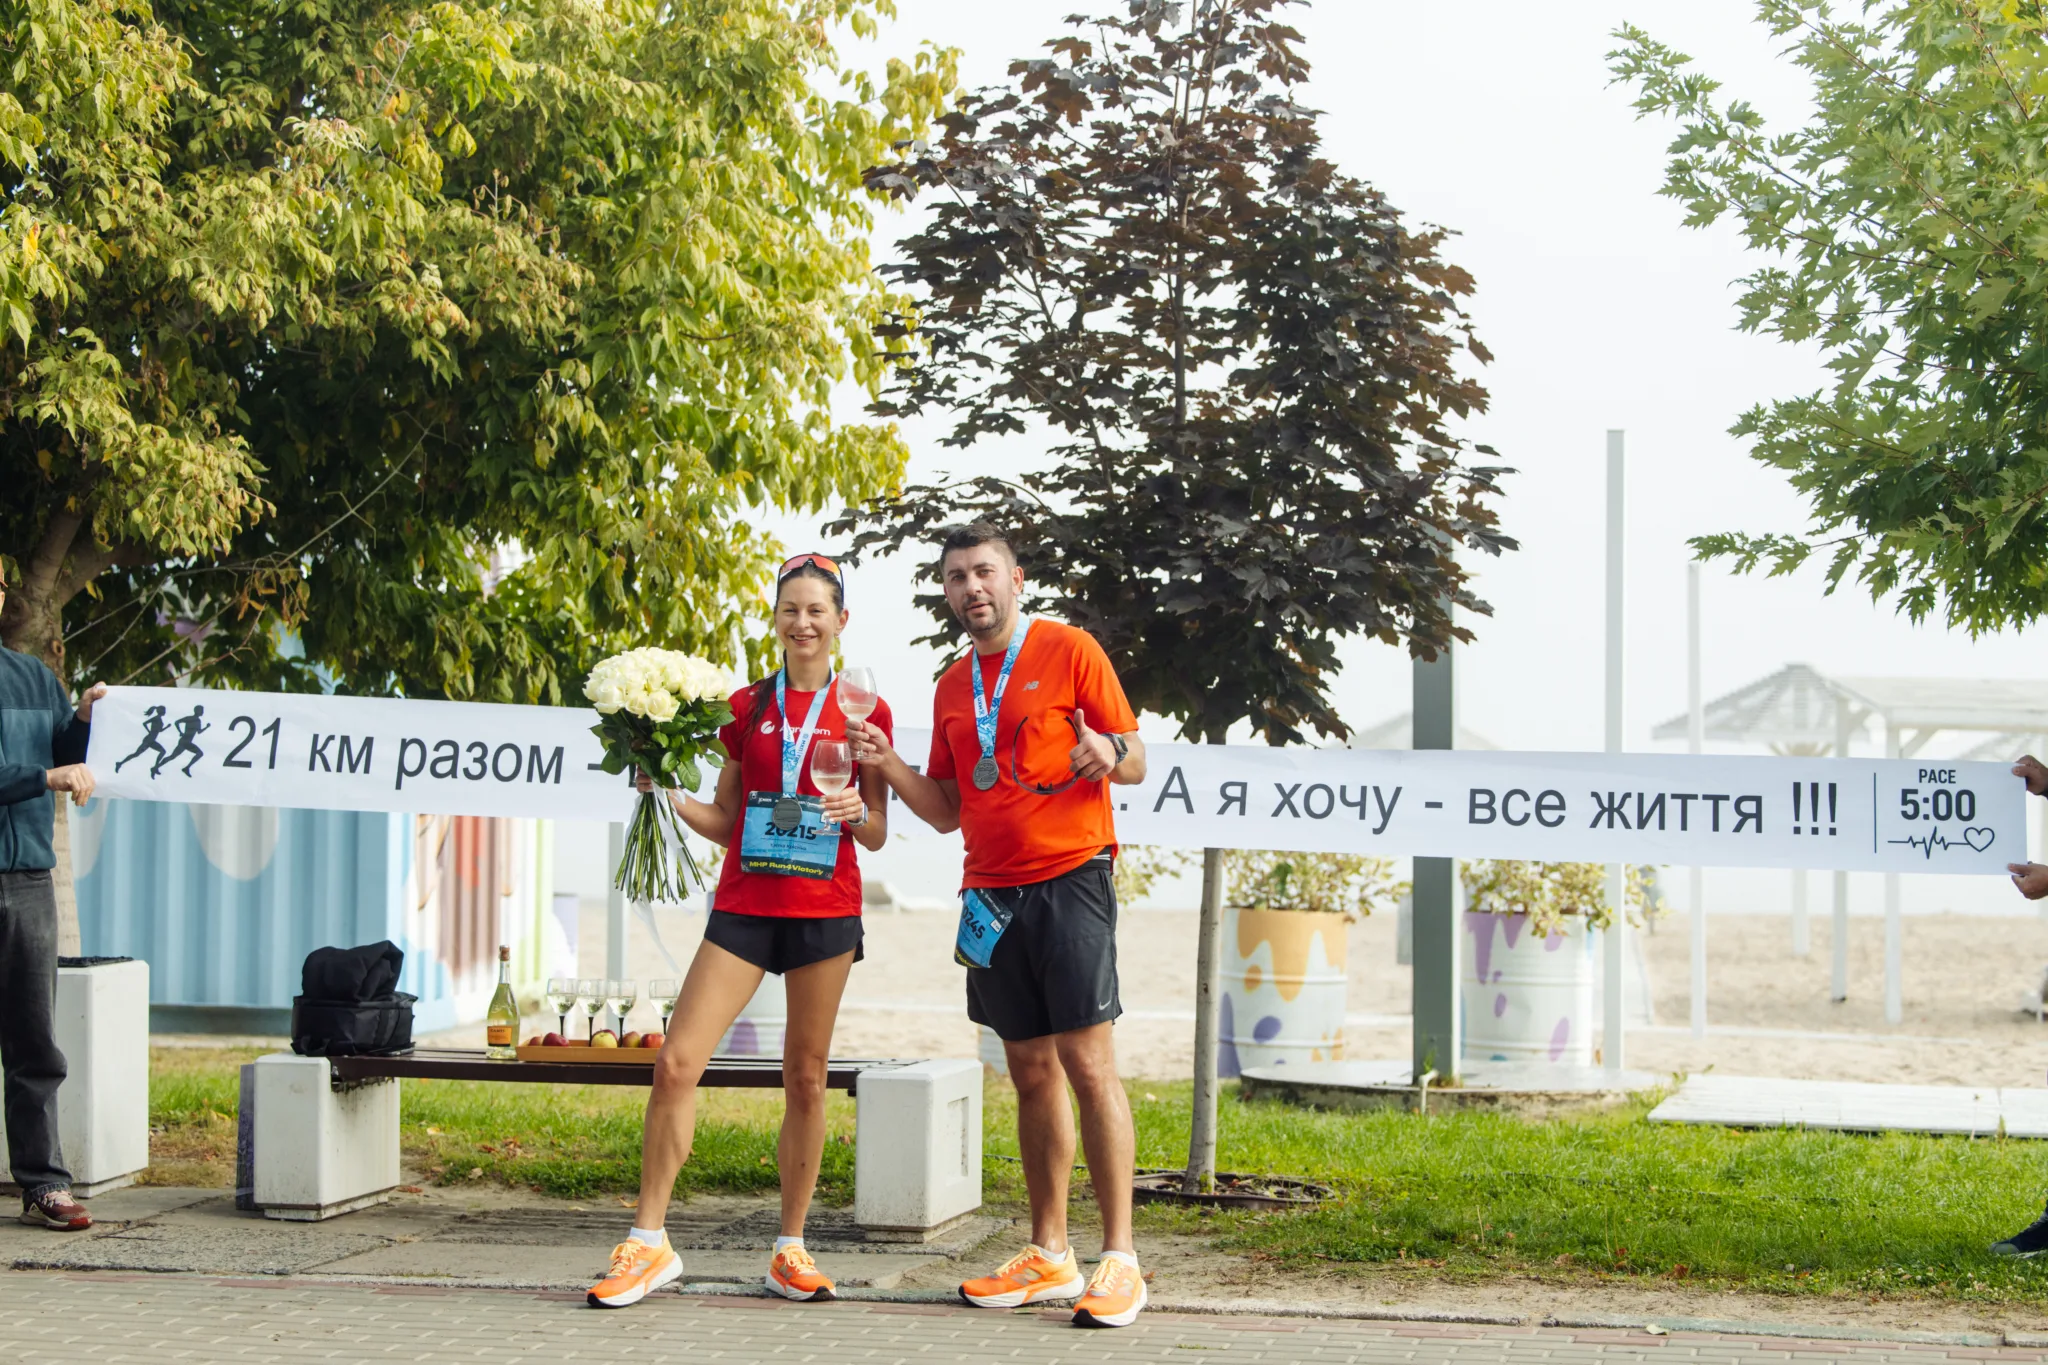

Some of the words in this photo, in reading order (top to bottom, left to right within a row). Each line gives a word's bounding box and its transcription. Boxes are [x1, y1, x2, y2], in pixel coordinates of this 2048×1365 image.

[223, 716, 280, 769] 21
[309, 734, 374, 774] км
[396, 738, 564, 790] разом
[1153, 767, 1194, 813] А
[1217, 781, 1248, 815] я
[1271, 783, 1402, 834] хочу
[1469, 789, 1566, 827] все
[1589, 791, 1763, 833] життя
[1793, 782, 1837, 835] !!!
[1919, 768, 1956, 784] PACE
[1901, 788, 1975, 821] 5:00
[769, 861, 824, 876] Run4Victory
